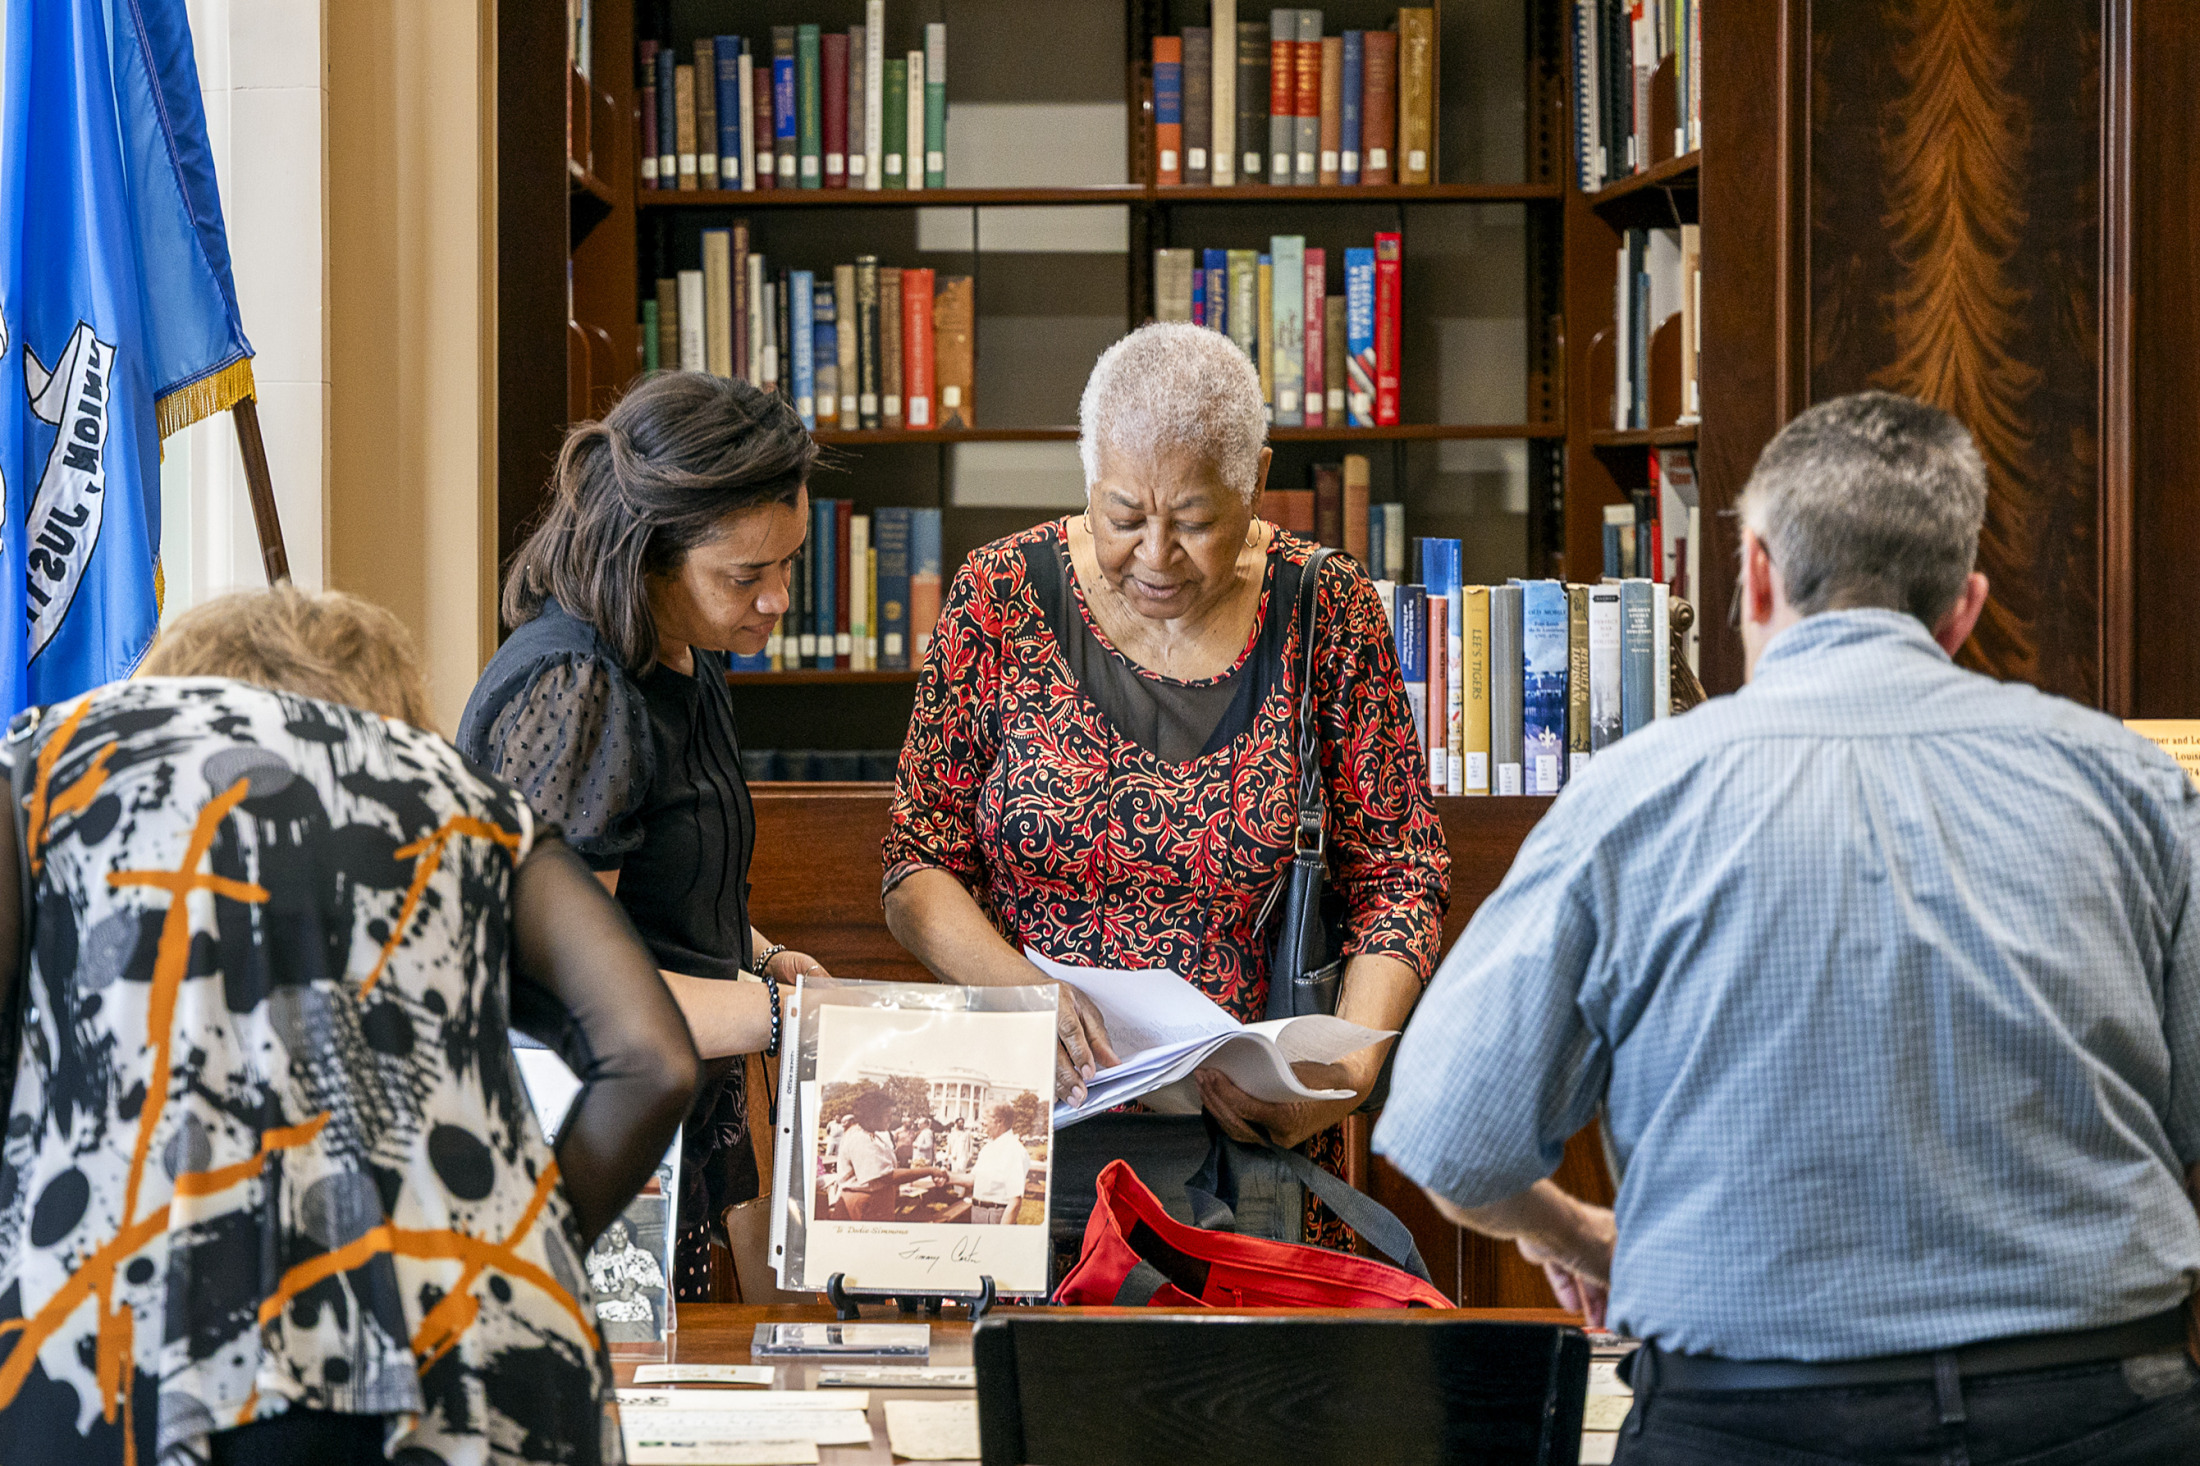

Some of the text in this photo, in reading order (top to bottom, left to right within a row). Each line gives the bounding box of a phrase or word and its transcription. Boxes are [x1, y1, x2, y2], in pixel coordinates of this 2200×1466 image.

[1472, 629, 1482, 700] LEE'S TIGERS
[1571, 646, 1580, 707] LOUISIANA
[1580, 647, 1588, 690] REVOLT
[2173, 735, 2188, 745] and
